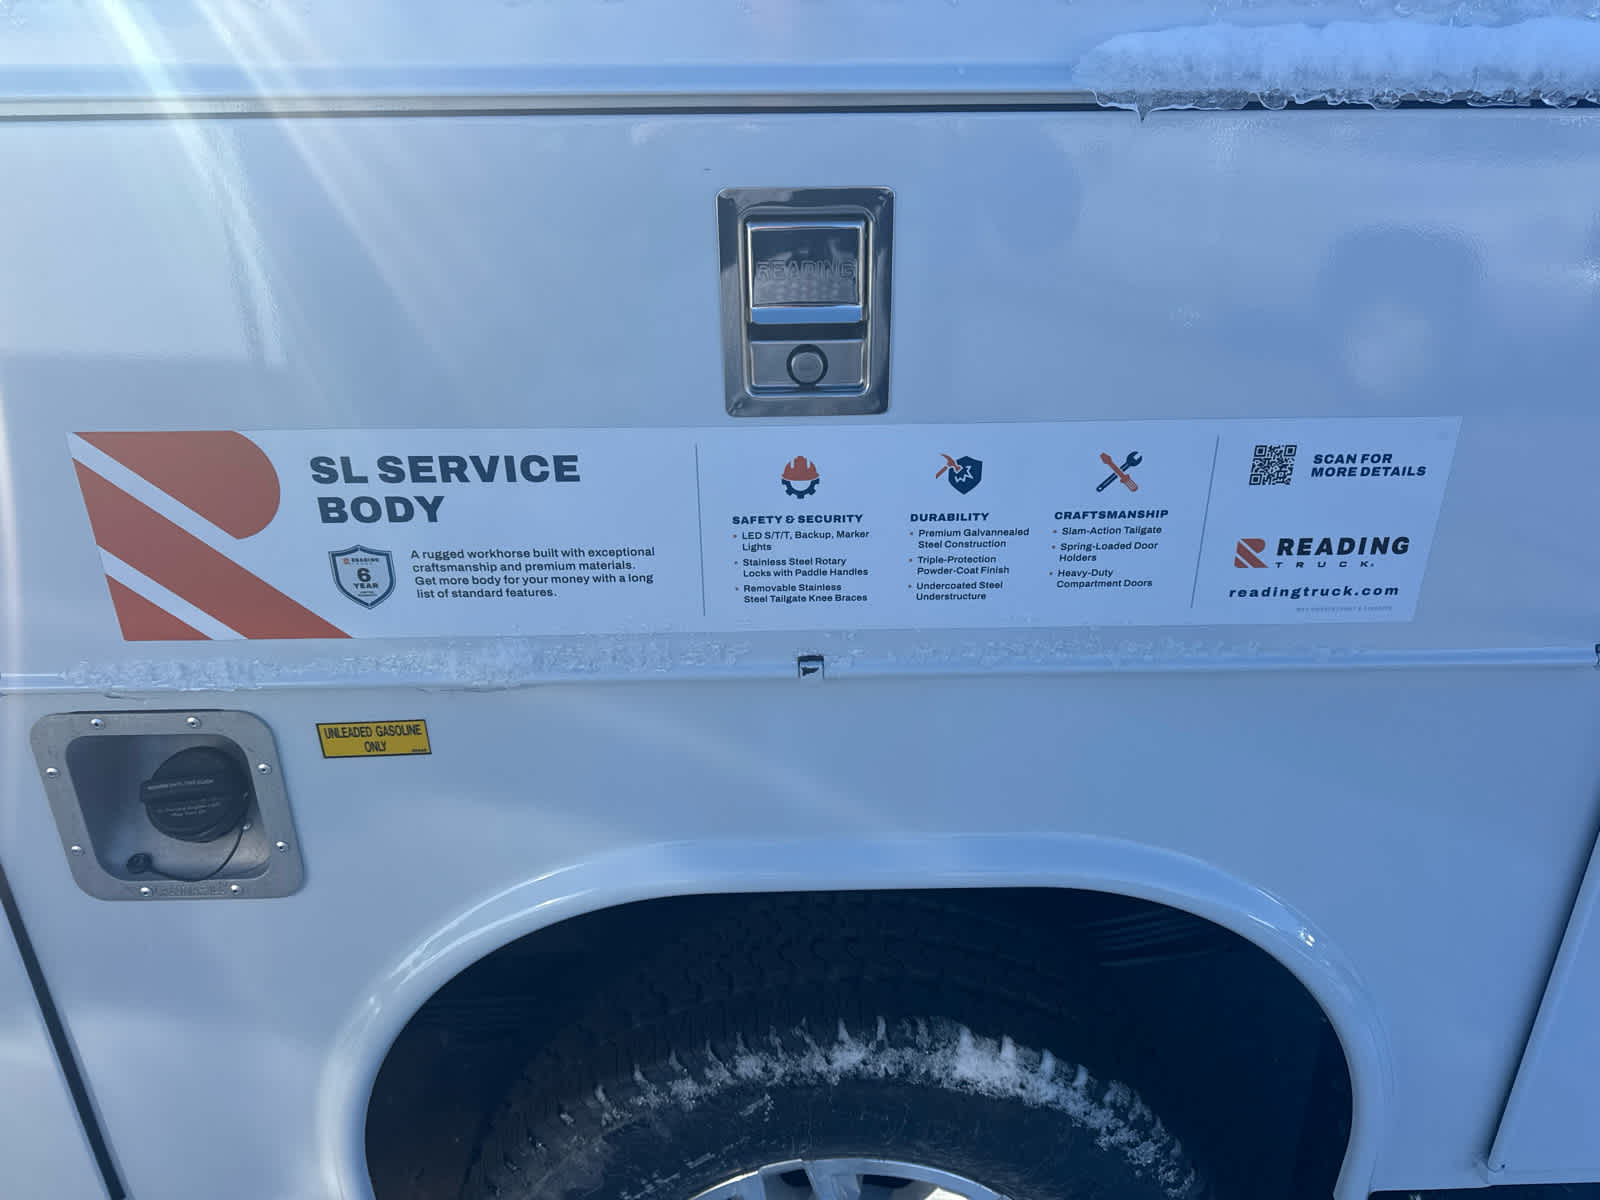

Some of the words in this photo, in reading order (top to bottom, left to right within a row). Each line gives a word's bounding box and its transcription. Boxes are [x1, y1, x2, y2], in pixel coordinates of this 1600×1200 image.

[756, 260, 857, 281] READING
[1313, 454, 1357, 464] SCAN
[1360, 453, 1392, 463] FOR
[310, 456, 368, 484] SL
[377, 455, 580, 484] SERVICE
[1311, 468, 1358, 477] MORE
[1360, 466, 1426, 477] DETAILS
[318, 496, 444, 523] BODY
[732, 516, 782, 524] SAFETY
[786, 516, 795, 524] &
[798, 514, 862, 523] SECURITY
[910, 512, 989, 522] DURABILITY
[1054, 510, 1168, 520] CRAFTSMANSHIP
[742, 532, 762, 540] LED
[764, 531, 793, 540] S/T/T,
[795, 530, 834, 539] Backup,
[836, 530, 869, 538] Marker
[918, 528, 961, 537] Premium
[964, 527, 1029, 536] Galvannealed
[1062, 526, 1122, 536] Slam-Action
[1124, 526, 1162, 536] Tailgate
[743, 543, 771, 552] Lights
[918, 540, 942, 549] Steel
[944, 539, 1006, 548] Construction
[1060, 542, 1132, 552] Spring-Loaded
[1134, 541, 1158, 550] Door
[1277, 537, 1410, 556] READING
[411, 549, 420, 559] A
[422, 549, 464, 560] rugged
[466, 548, 530, 558] workhorse
[533, 547, 559, 558] built
[561, 547, 584, 557] with
[588, 547, 655, 559] exceptional
[1059, 553, 1096, 562] Holders
[815, 557, 846, 566] Rotary
[918, 555, 996, 565] Triple-Protection
[412, 562, 497, 574] craftsmanship
[499, 561, 521, 571] and
[524, 561, 576, 572] premium
[578, 560, 635, 570] materials.
[917, 567, 978, 575] Powder-Coat
[981, 566, 1009, 575] Finish
[357, 568, 371, 582] 6
[743, 569, 771, 577] Locks
[1058, 568, 1113, 578] Heavy-Duty
[416, 575, 434, 586] Get
[439, 575, 469, 585] more
[472, 575, 501, 586] body
[503, 574, 520, 584] for
[522, 575, 548, 586] your
[551, 574, 589, 585] money
[591, 573, 616, 584] with
[619, 575, 626, 583] a
[628, 573, 653, 585] long
[1056, 580, 1121, 589] Compartment
[1123, 579, 1152, 587] Doors
[744, 584, 796, 592] Removable
[917, 581, 977, 590] Undercoated
[979, 581, 1003, 589] Steel
[417, 588, 434, 598] list
[437, 588, 449, 598] of
[451, 587, 502, 598] standard
[505, 587, 557, 597] features.
[916, 592, 986, 601] Understructure
[1229, 586, 1399, 599] readingtruck.com
[744, 595, 768, 603] Steel
[770, 595, 806, 604] Tailgate
[324, 727, 372, 739] UNLEADED
[376, 724, 422, 737] GASOLINE
[364, 741, 386, 752] ONLY
